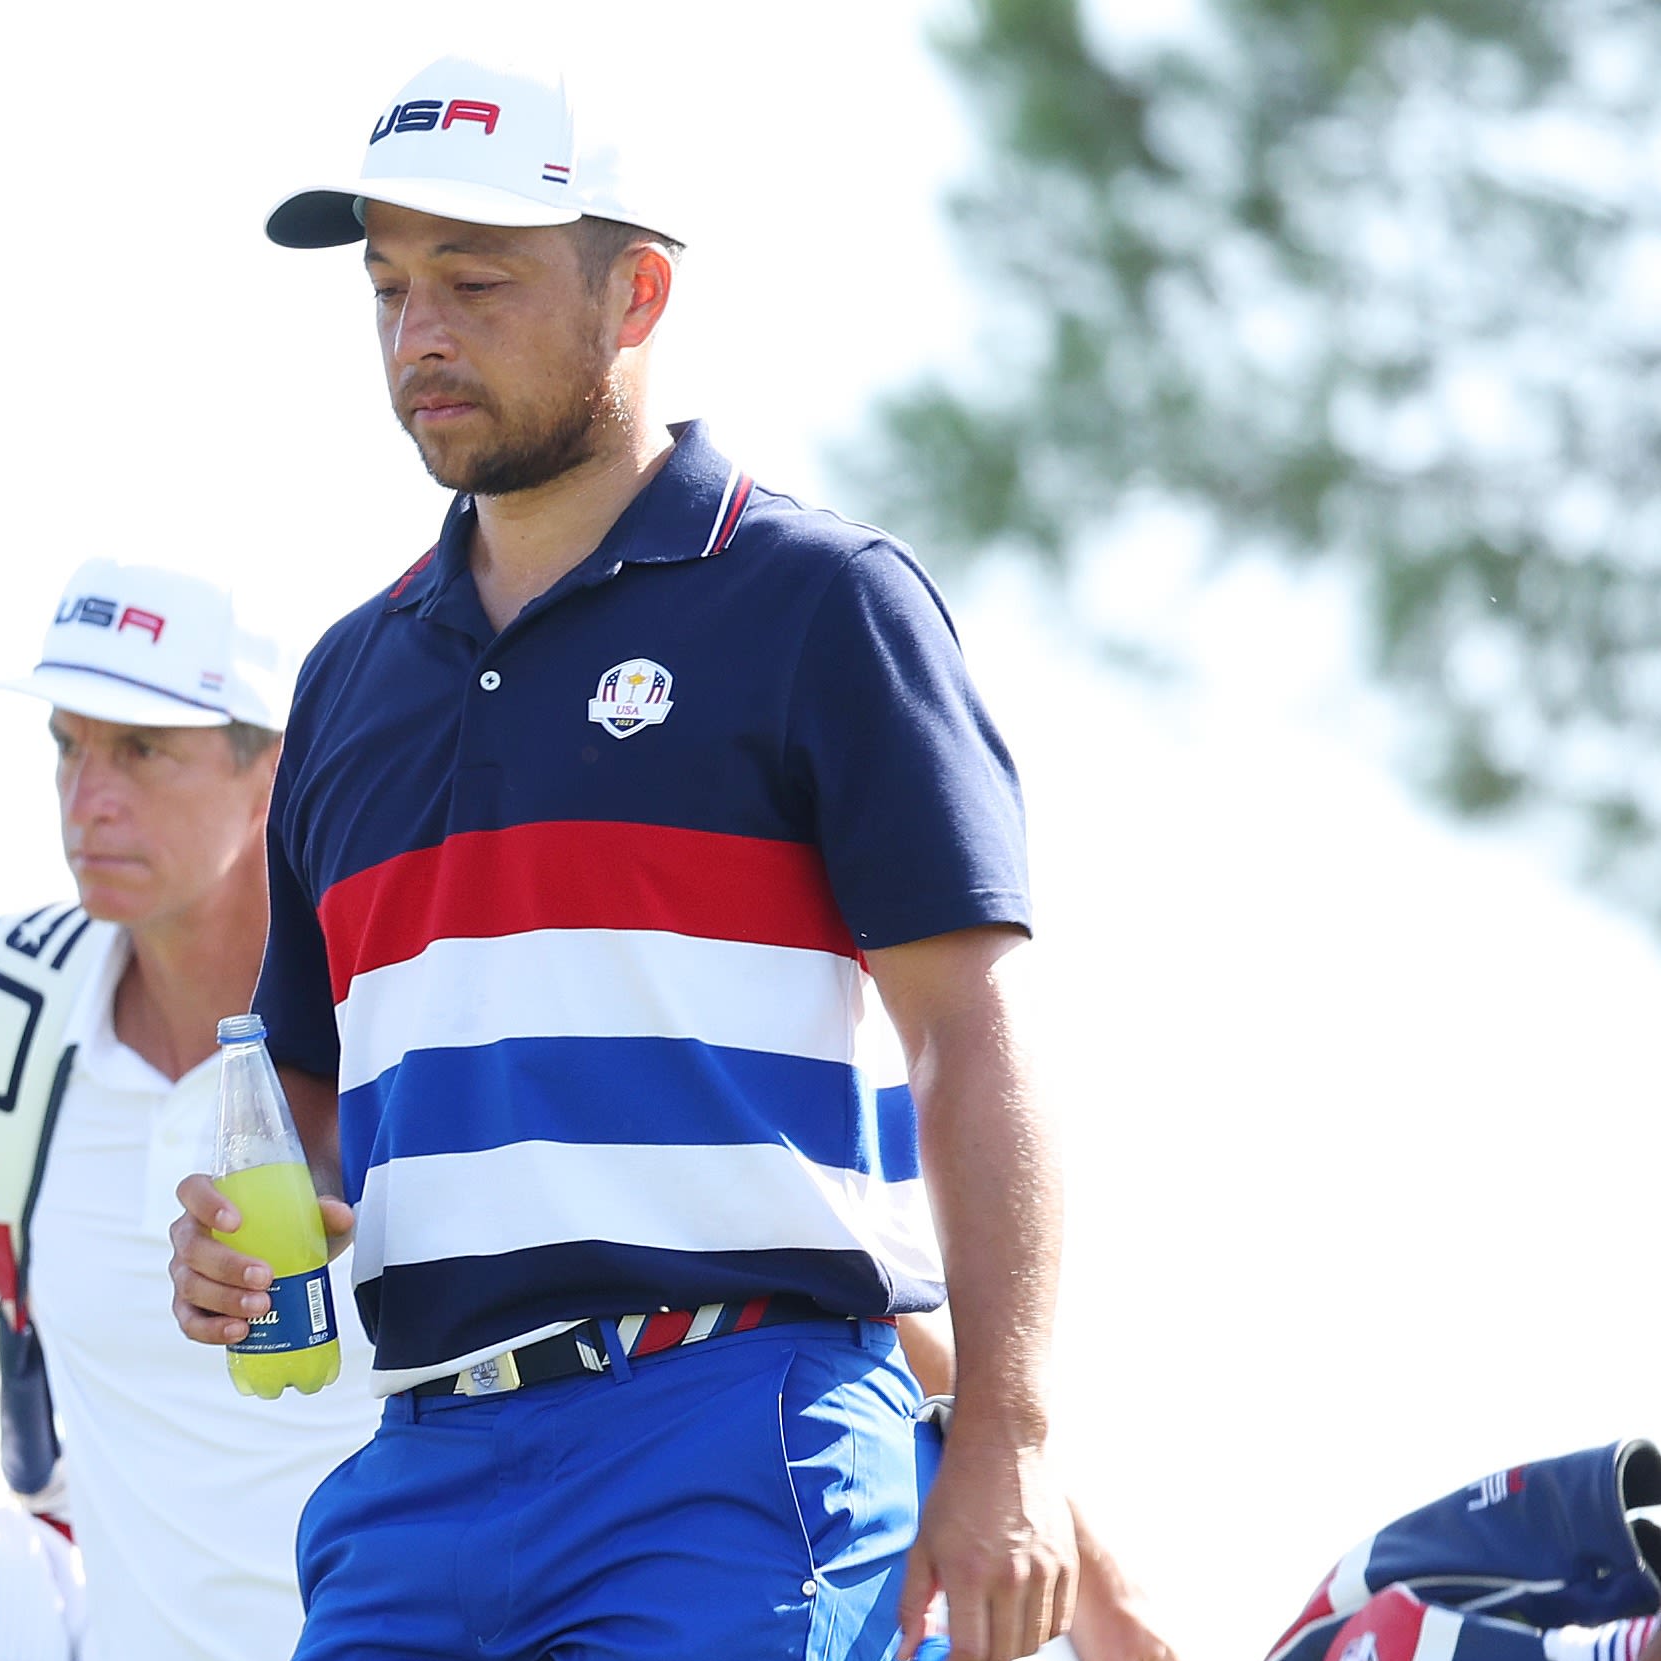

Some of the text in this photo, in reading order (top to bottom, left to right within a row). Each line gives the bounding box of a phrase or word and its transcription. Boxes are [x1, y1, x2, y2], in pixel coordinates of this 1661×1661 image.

[369, 98, 501, 146] USA
[55, 596, 167, 646] USA
[616, 704, 640, 715] USA
